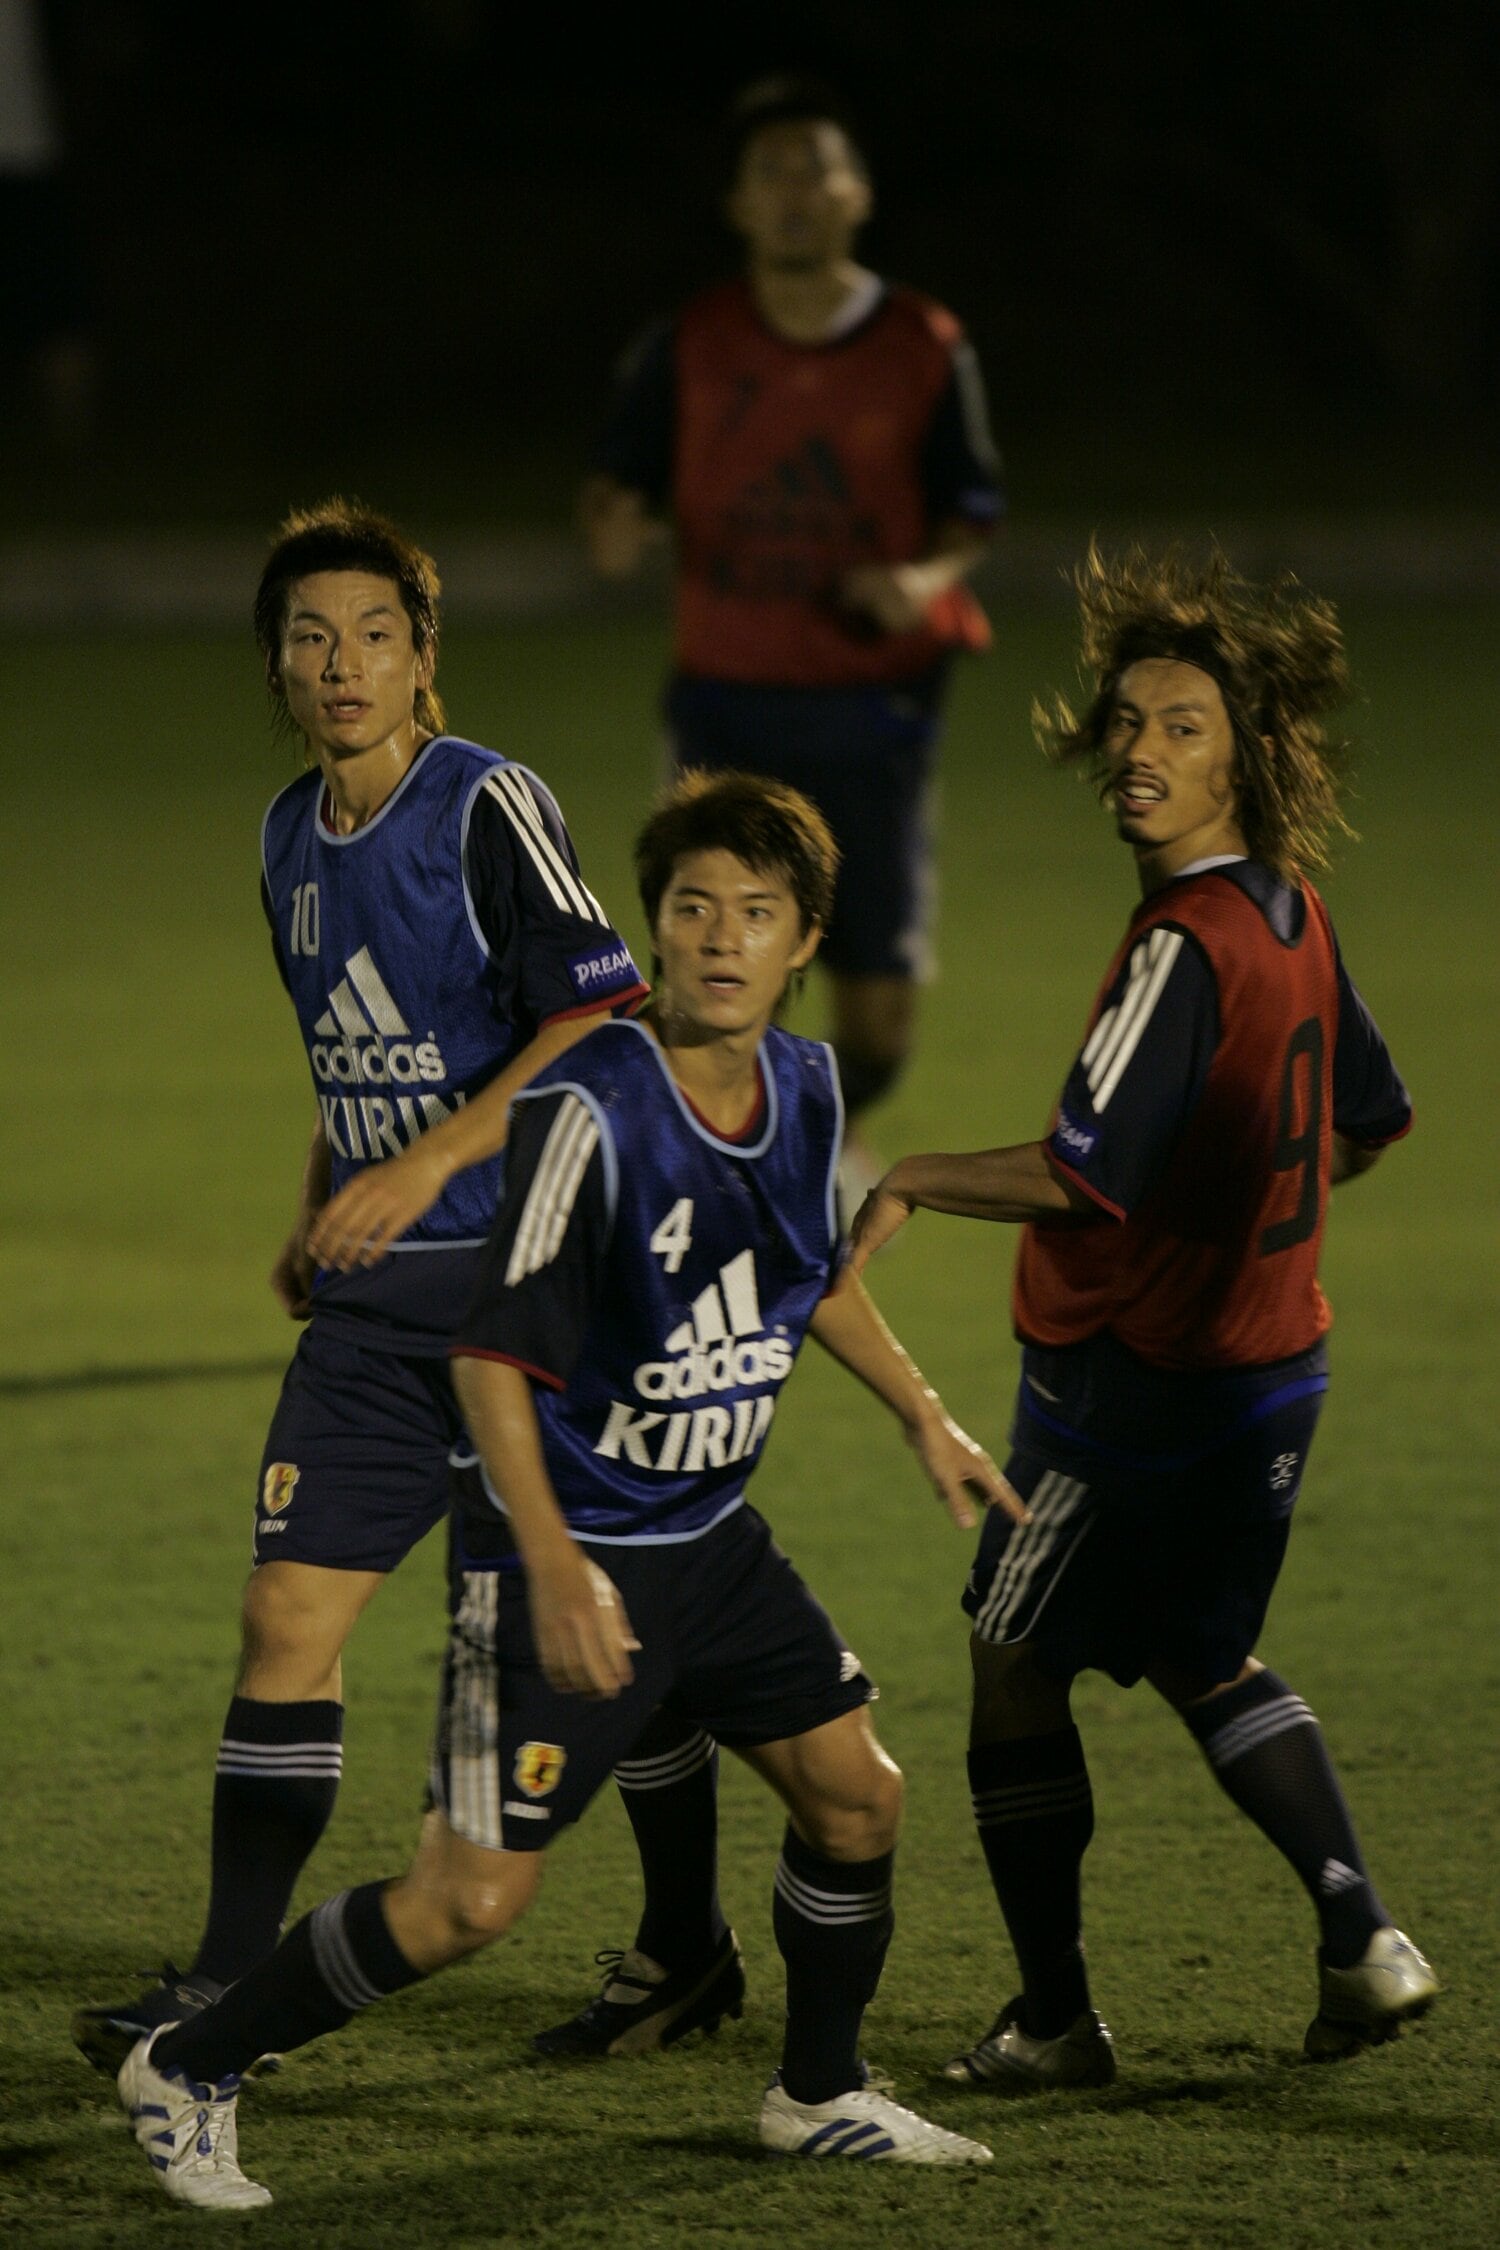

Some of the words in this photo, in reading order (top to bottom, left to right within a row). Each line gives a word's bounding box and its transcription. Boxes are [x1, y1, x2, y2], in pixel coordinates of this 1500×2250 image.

[291, 881, 320, 957] 10
[574, 949, 634, 986] DREAM
[312, 1033, 448, 1084] adidas
[1259, 1016, 1323, 1256] 9
[650, 1197, 694, 1273] 4
[632, 1335, 793, 1400] adidas
